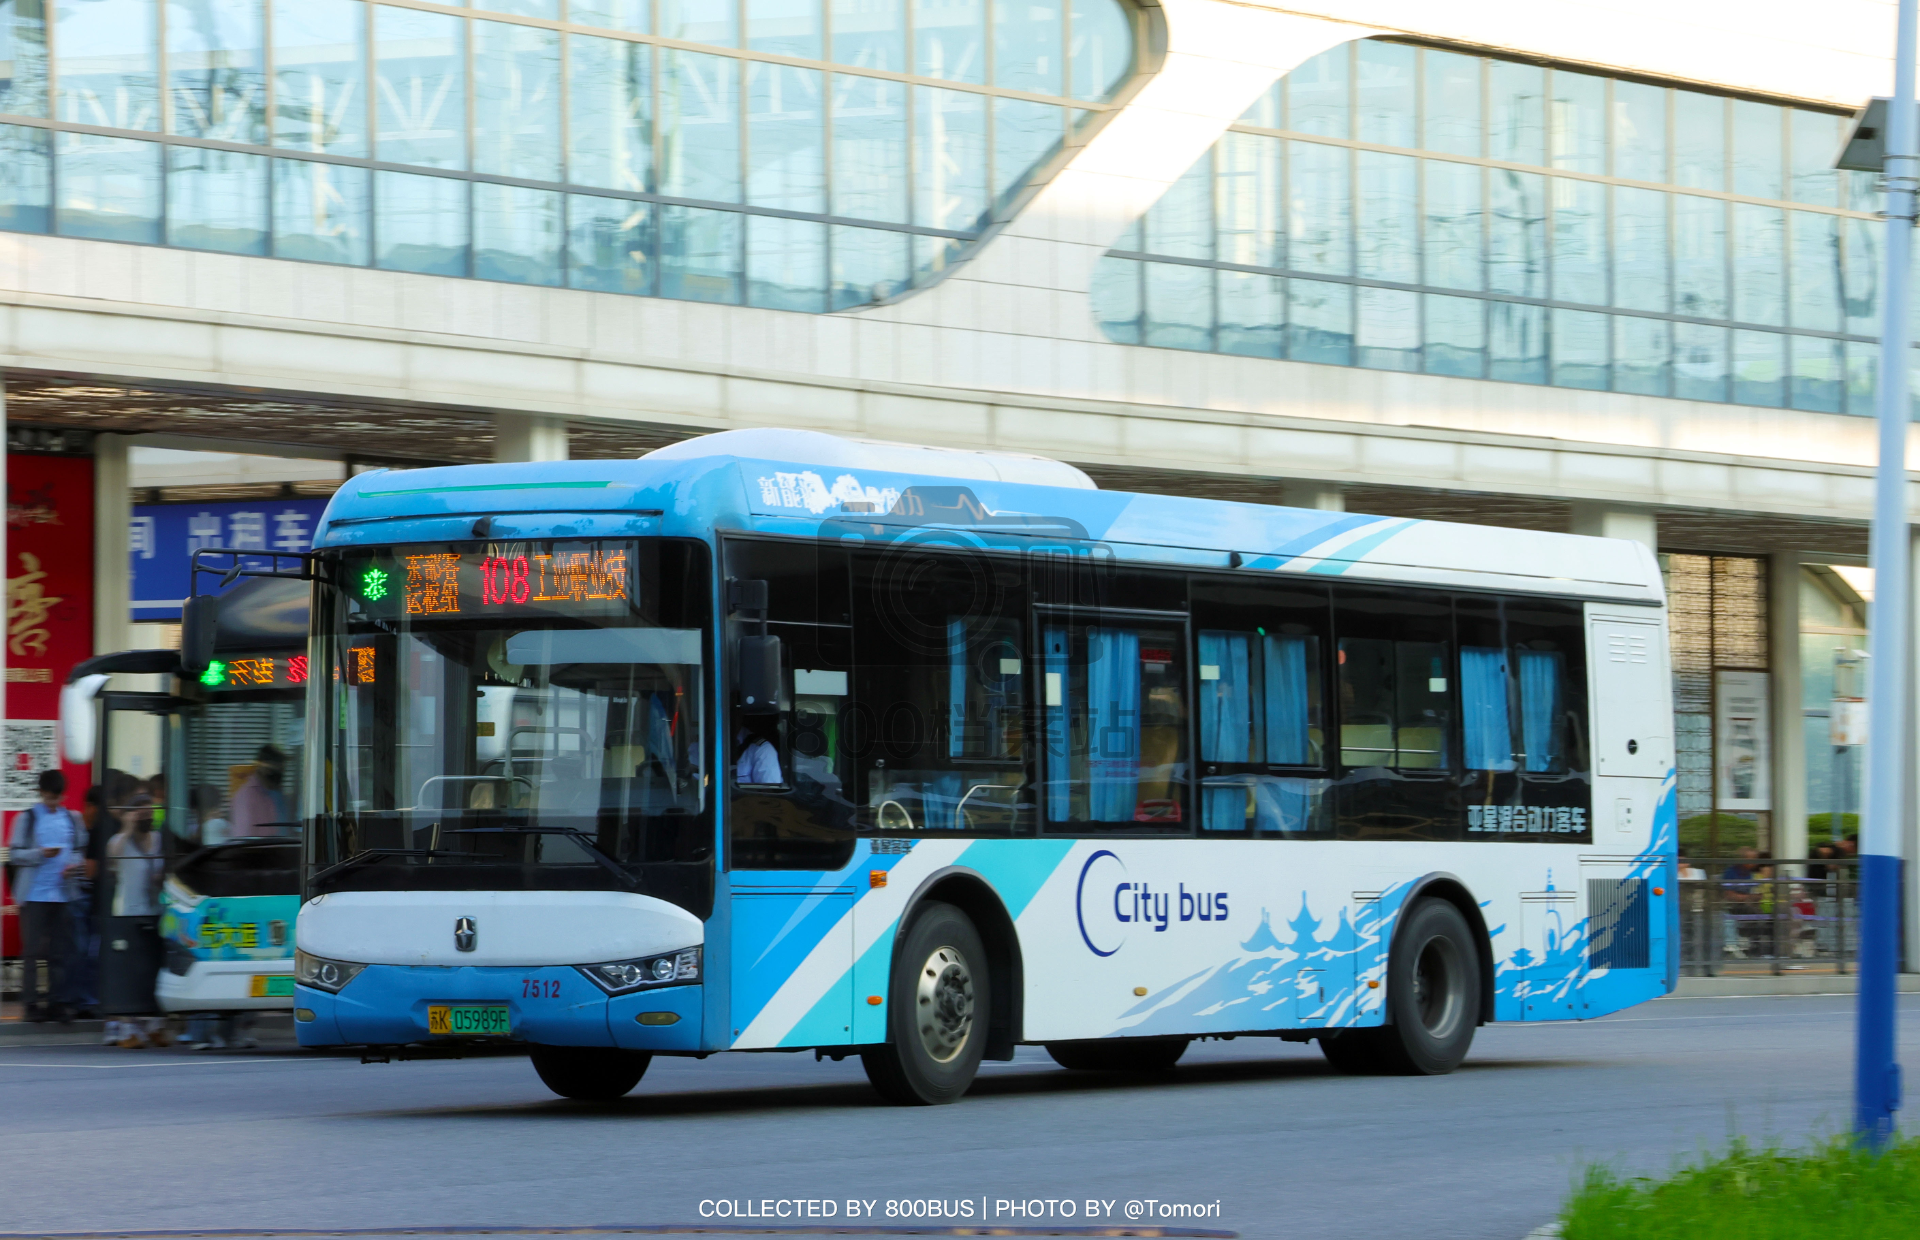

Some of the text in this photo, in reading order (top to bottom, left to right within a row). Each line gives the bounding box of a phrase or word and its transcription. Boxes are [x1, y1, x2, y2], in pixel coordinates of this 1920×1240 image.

[187, 509, 312, 558] 出租车
[479, 555, 531, 605] 108
[1114, 882, 1229, 933] City bus
[522, 979, 561, 999] 7512
